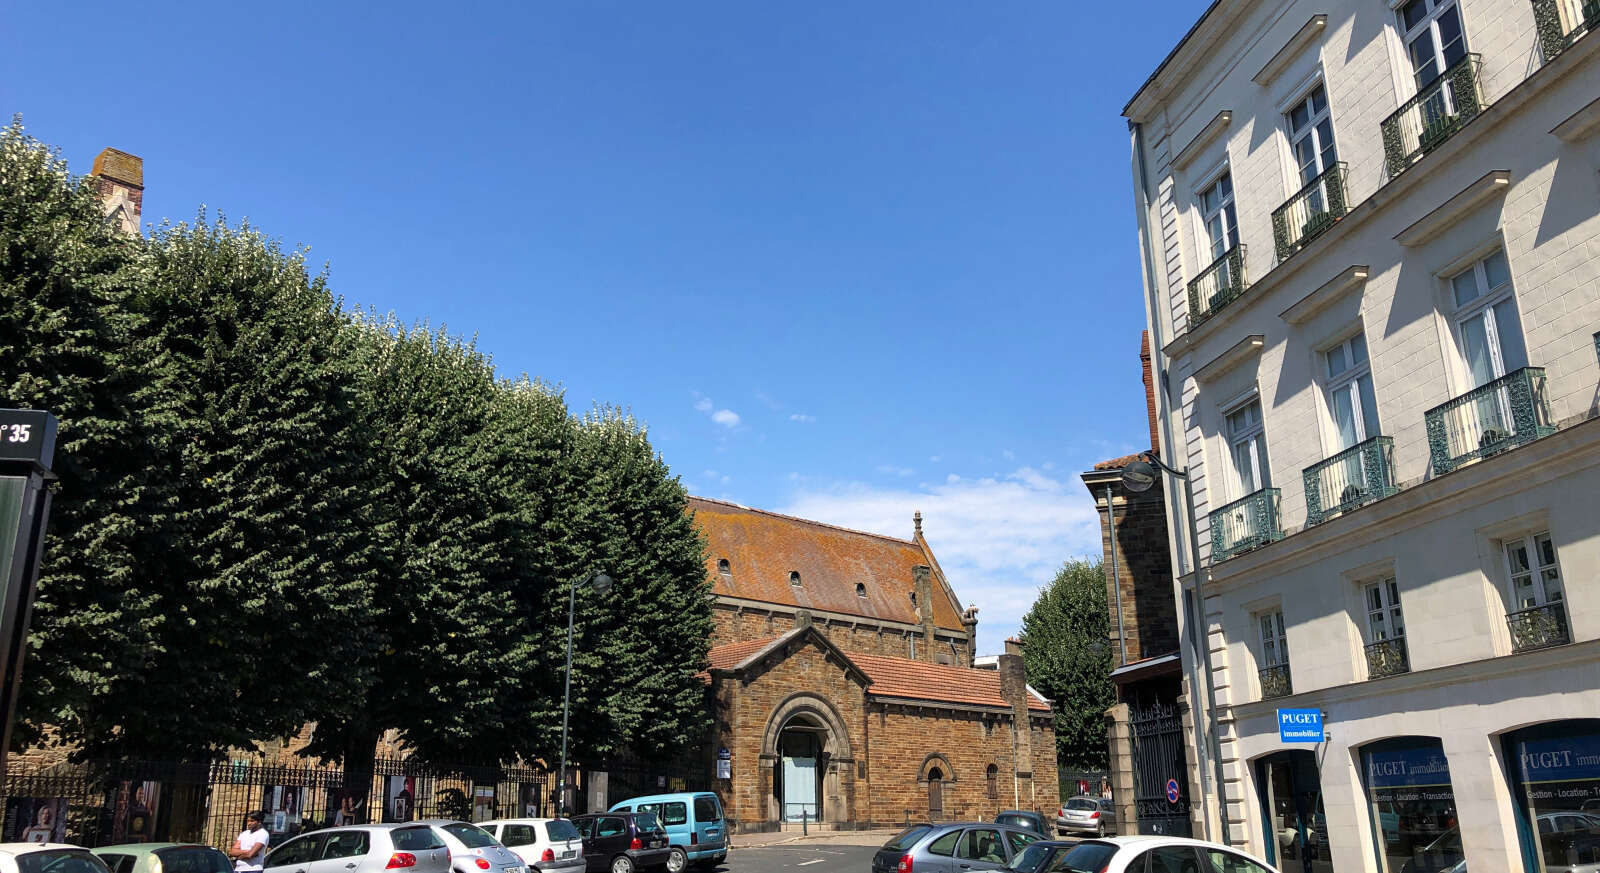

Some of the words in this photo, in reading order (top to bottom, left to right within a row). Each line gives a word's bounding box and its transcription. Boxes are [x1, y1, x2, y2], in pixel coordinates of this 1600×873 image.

[9, 424, 32, 442] 35
[1282, 713, 1318, 723] PUGET
[1521, 750, 1572, 768] PUGET
[1369, 761, 1406, 777] PUGET
[1527, 790, 1553, 799] Gestion
[1558, 787, 1588, 798] Location
